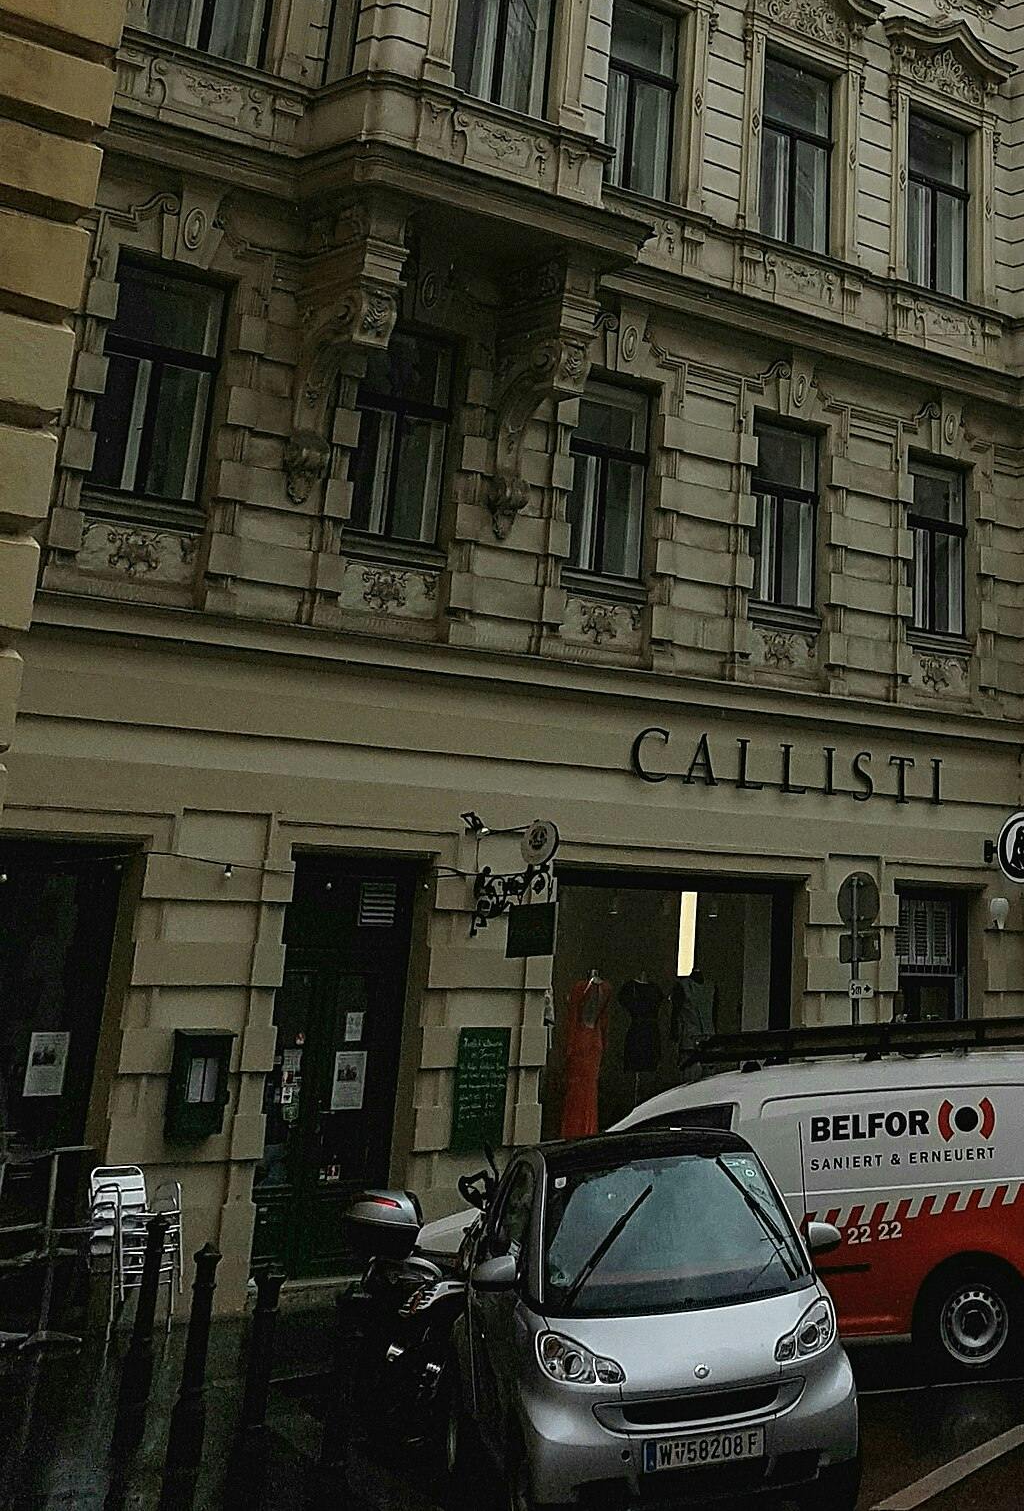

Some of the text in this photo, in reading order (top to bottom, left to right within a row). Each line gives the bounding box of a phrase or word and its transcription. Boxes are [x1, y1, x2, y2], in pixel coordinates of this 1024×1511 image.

[630, 726, 944, 805] CALLISTI
[850, 983, 862, 995] 5m
[810, 1109, 930, 1142] BELFOR
[810, 1147, 996, 1171] SANIERT & ERNEUERT
[847, 1221, 902, 1244] 22 22
